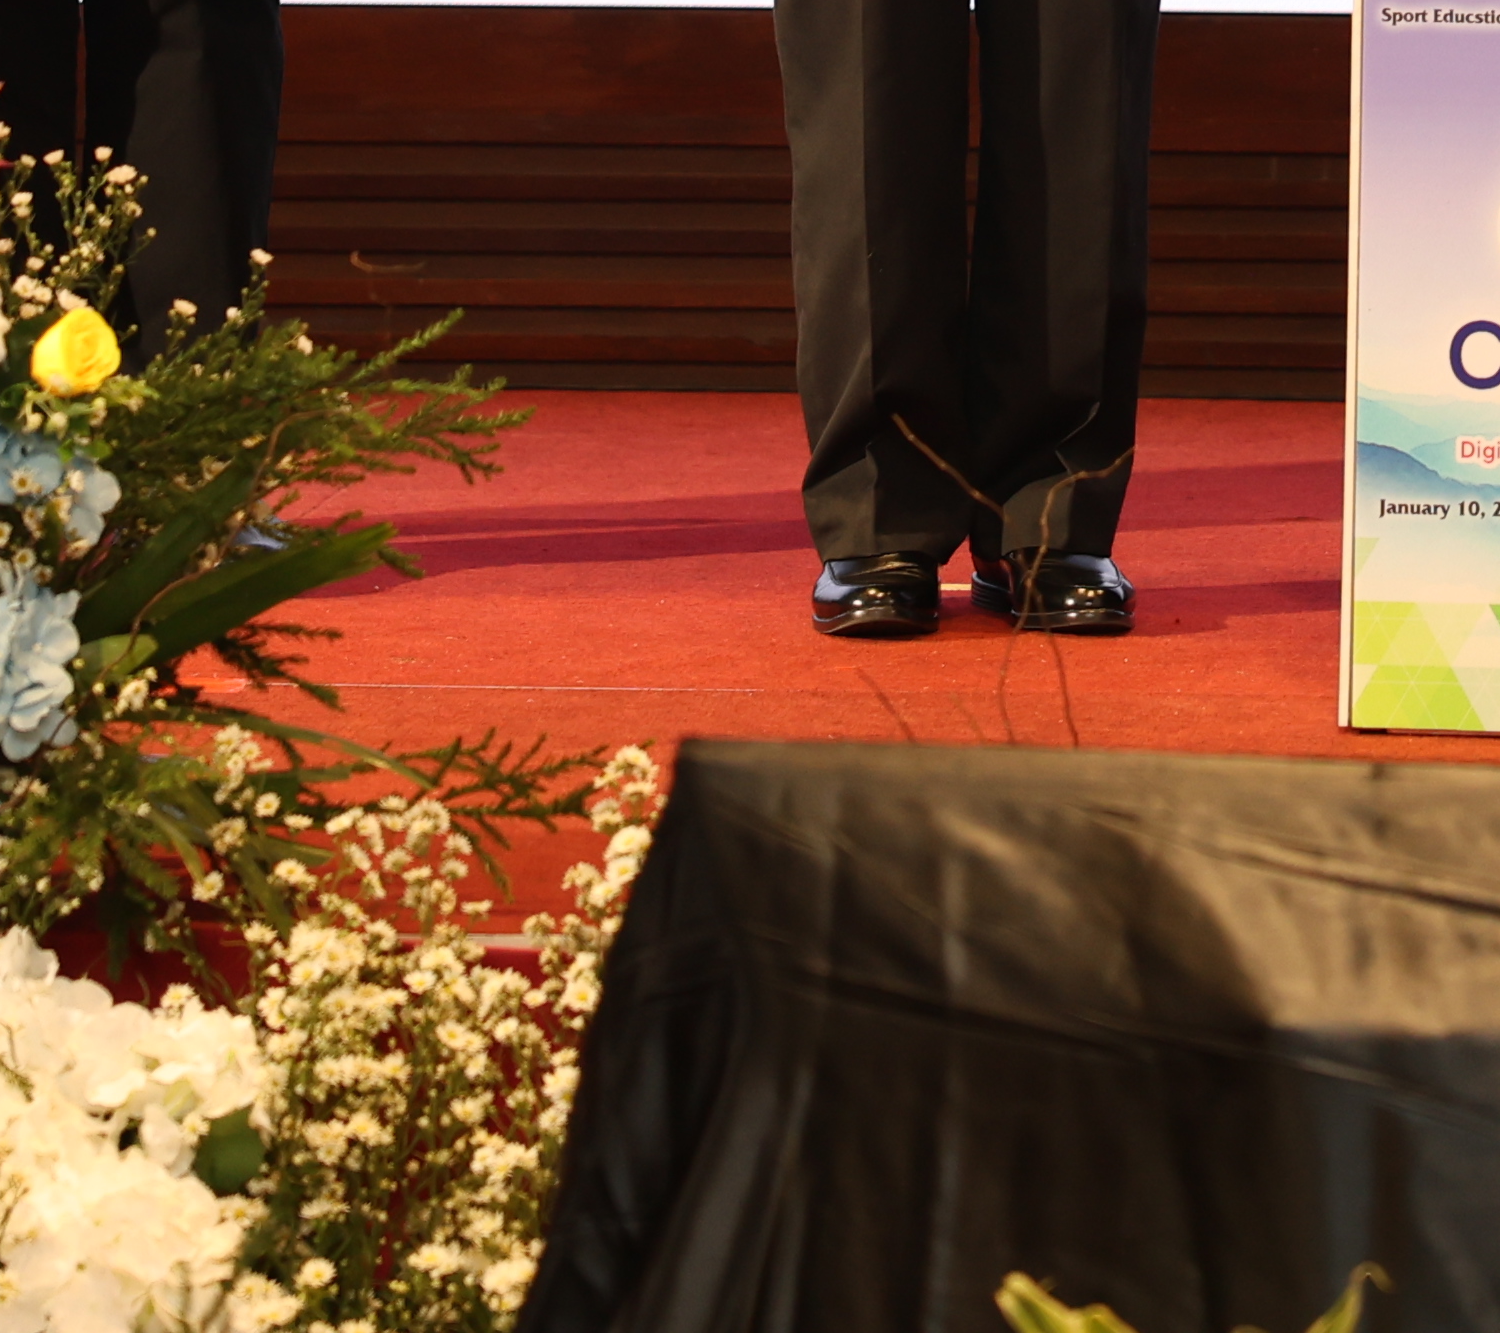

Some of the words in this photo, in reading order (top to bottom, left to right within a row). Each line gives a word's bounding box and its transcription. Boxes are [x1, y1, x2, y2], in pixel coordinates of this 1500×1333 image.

[1381, 7, 1428, 26] Sport
[1379, 499, 1450, 520] January
[1458, 501, 1486, 519] 10,
